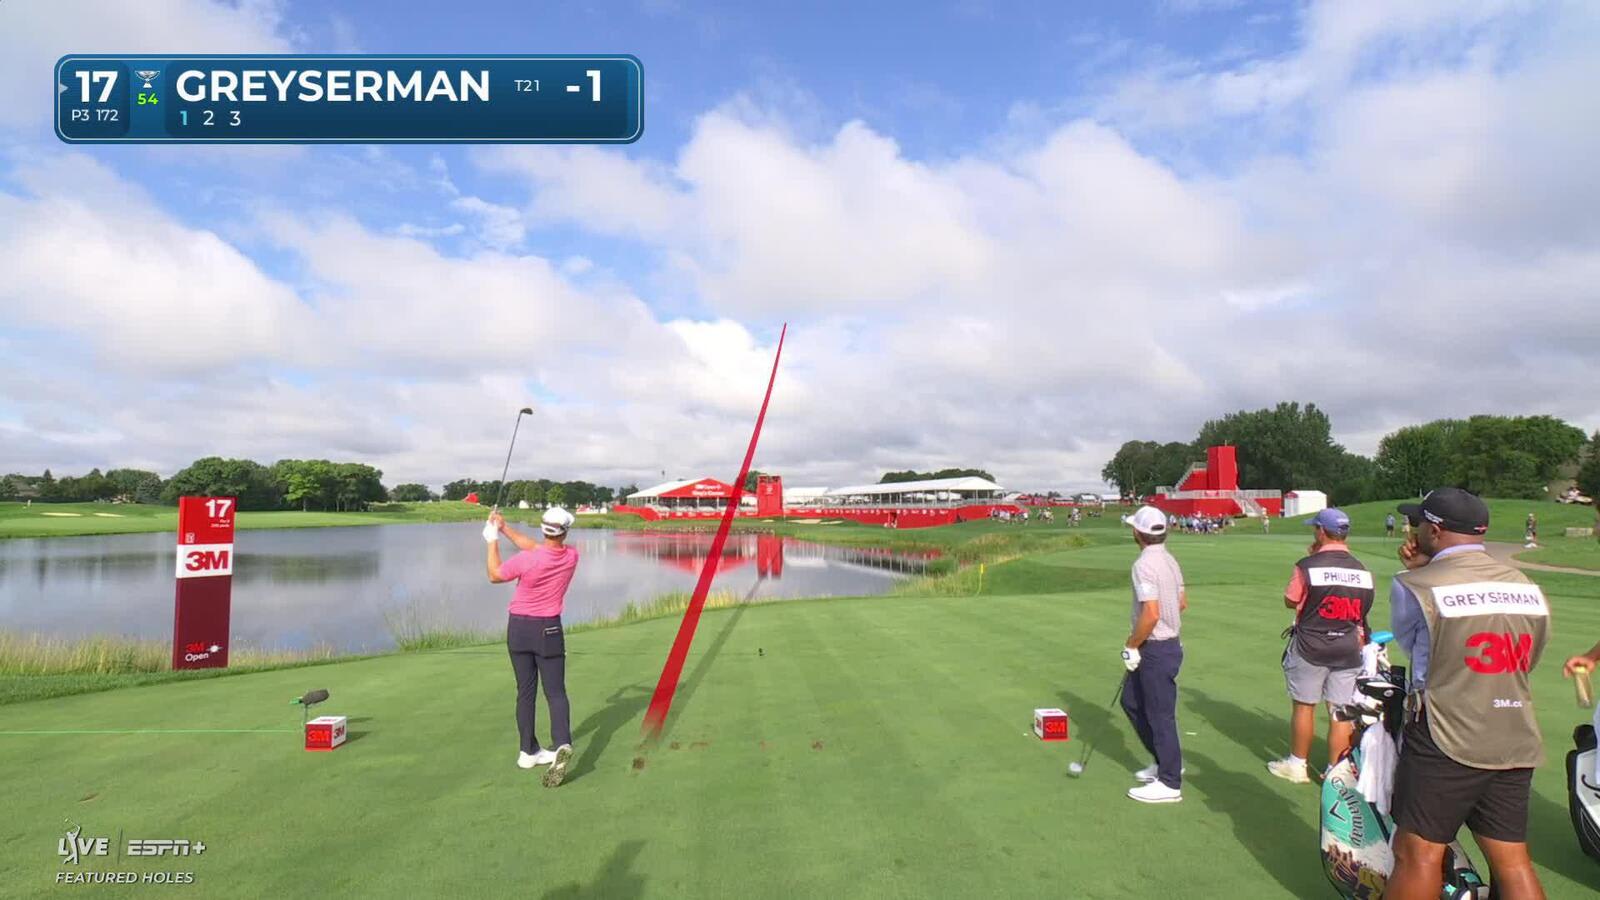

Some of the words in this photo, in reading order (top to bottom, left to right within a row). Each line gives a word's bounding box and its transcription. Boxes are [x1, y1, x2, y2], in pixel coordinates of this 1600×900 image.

[205, 499, 232, 518] 17
[185, 551, 229, 571] 3M
[1323, 572, 1361, 583] PHILLIPS
[1318, 596, 1361, 621] 3M
[1442, 592, 1541, 607] GREYSERMAN
[185, 652, 209, 662] Open
[1464, 632, 1533, 675] 3M
[1331, 776, 1364, 848] Callaway
